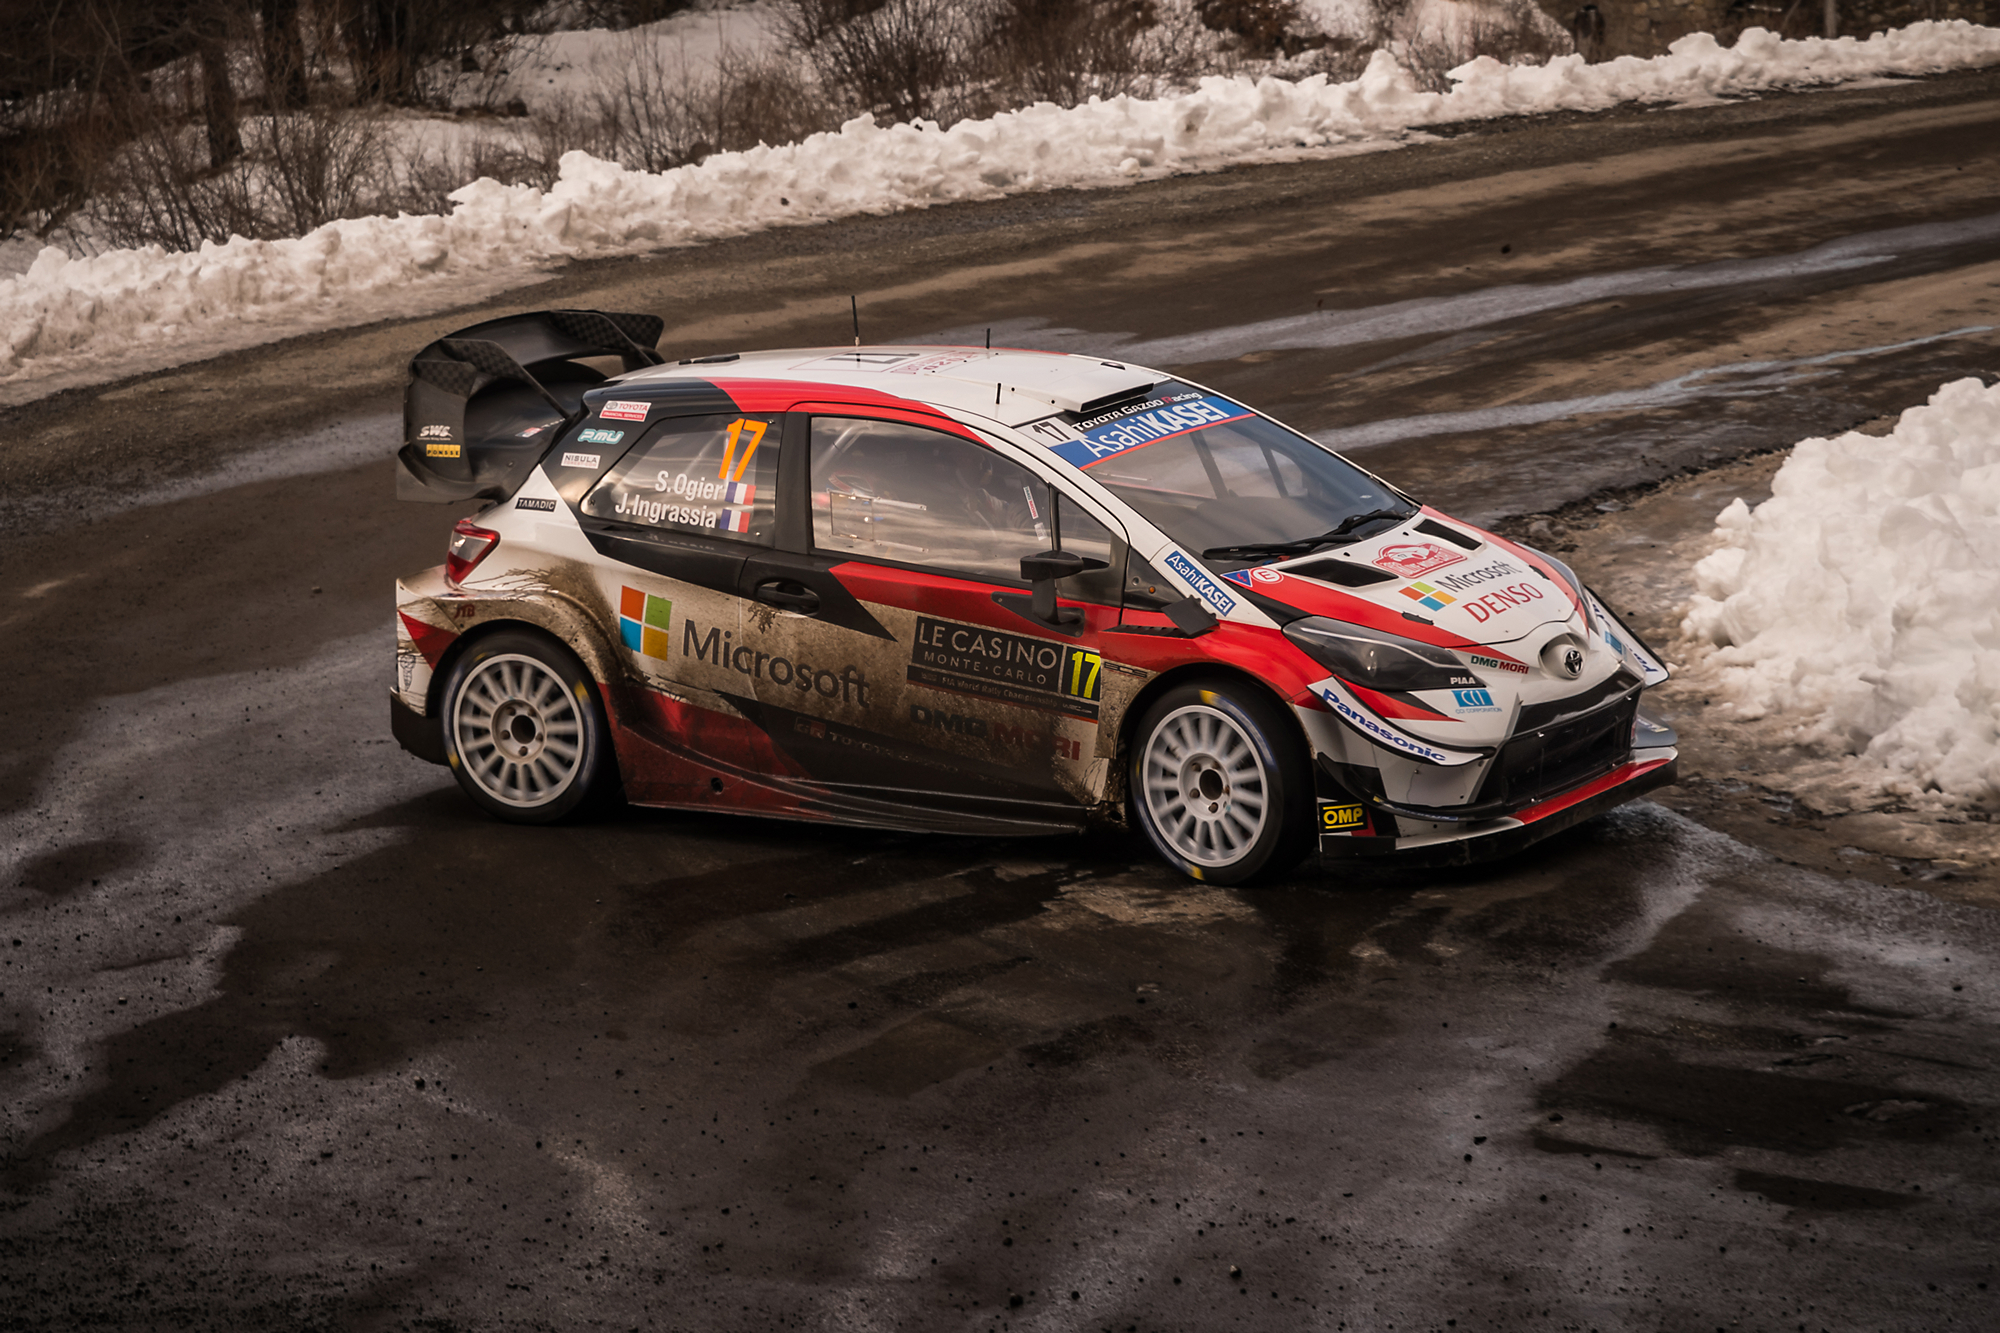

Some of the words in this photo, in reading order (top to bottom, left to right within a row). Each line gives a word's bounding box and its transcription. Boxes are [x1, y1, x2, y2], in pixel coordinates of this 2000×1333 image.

[619, 403, 648, 411] TOYOTA
[1072, 410, 1122, 431] TOYOTA
[1121, 400, 1164, 417] GAZOO
[1162, 391, 1203, 404] Racing
[1031, 421, 1071, 441] 17
[565, 454, 597, 463] NISULA
[718, 418, 768, 481] 17
[655, 470, 724, 501] S.Ogier
[518, 499, 555, 511] TAMADIC
[615, 493, 716, 528] J.Ingrassia
[1435, 560, 1522, 592] Microsoft
[454, 604, 475, 619] JTB
[1462, 583, 1543, 623] DENSO
[919, 622, 945, 647] LE
[951, 630, 1058, 669] CASINO
[683, 619, 870, 708] Microsoft
[1070, 651, 1101, 699] 17
[1471, 655, 1498, 668] DMG
[1499, 661, 1529, 674] MORI
[957, 678, 979, 691] World
[982, 683, 1001, 697] Rally
[1450, 677, 1476, 685] PIAA
[1322, 688, 1446, 761] Panasonic
[1323, 807, 1363, 825] OMP
